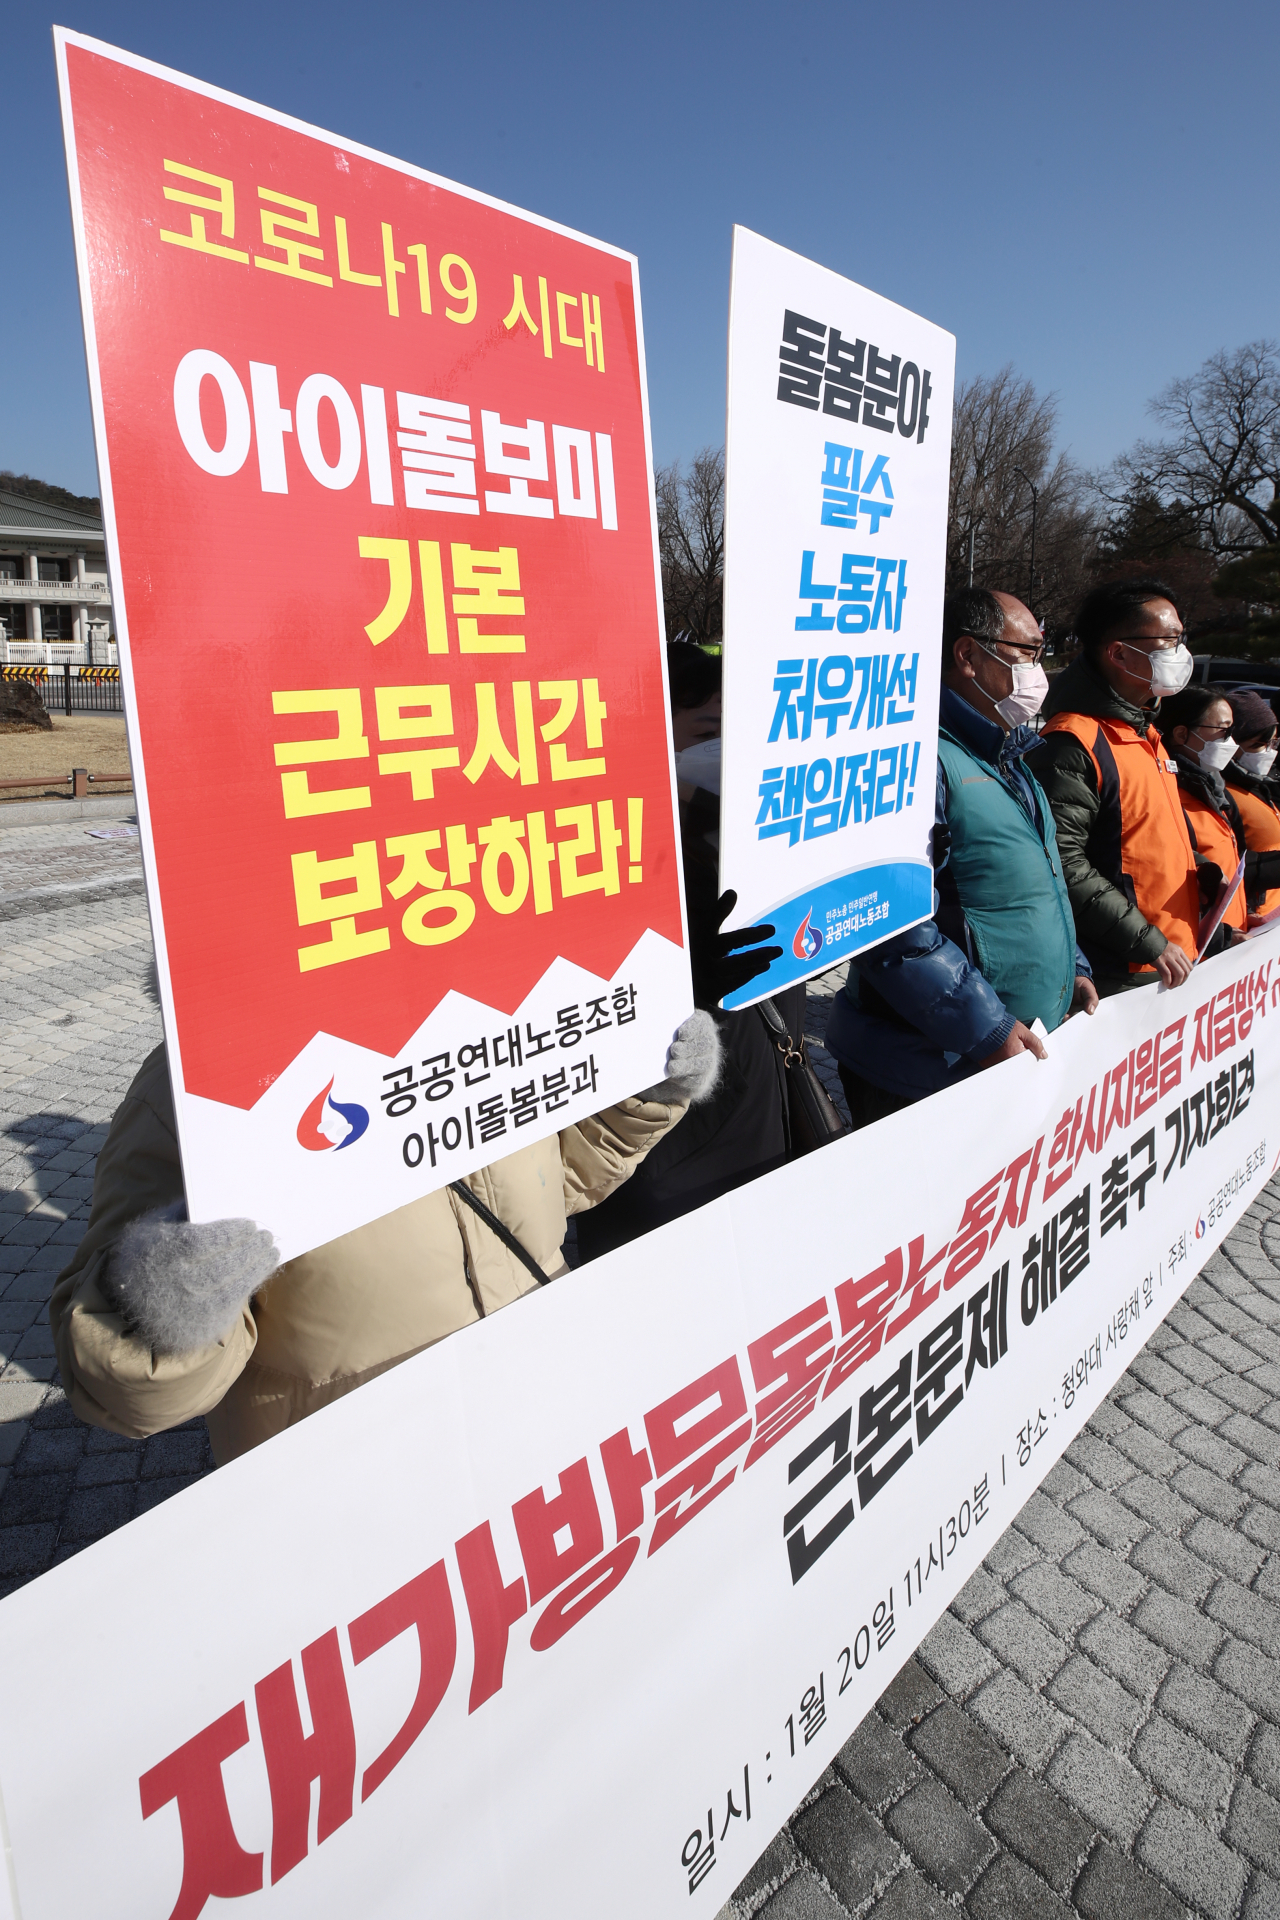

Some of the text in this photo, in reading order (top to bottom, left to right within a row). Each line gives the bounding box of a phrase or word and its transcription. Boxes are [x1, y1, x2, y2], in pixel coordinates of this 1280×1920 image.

[159, 158, 606, 373] 코로나19 시대
[173, 348, 618, 531] 아이돌보미
[777, 308, 932, 444] 돌봄분야
[821, 441, 894, 535] 필수
[358, 535, 526, 654] 기본
[794, 550, 907, 634] 노동자
[271, 678, 607, 820] 근무시간
[767, 652, 920, 743] 처우개선
[755, 741, 921, 848] 책임져라!
[291, 797, 644, 973] 보장하라!
[825, 900, 890, 945] 공공연대노동조합
[826, 904, 848, 923] 민주노총
[380, 983, 638, 1118] 공공연대노동조합
[402, 1055, 599, 1168] 아이돌봄분과
[783, 1048, 1255, 1586] 근본문제 해결 촉구 기자회견
[138, 958, 1274, 1920] 재가방문돌봄노동자 한시지원금 지급방식
[680, 1763, 752, 1896] 일시
[784, 1672, 828, 1759] 1월
[836, 1587, 897, 1697] 20일
[903, 1472, 991, 1608] 11시30분
[1016, 1407, 1049, 1467] 장소
[1062, 1333, 1102, 1410] 청와대
[1105, 1286, 1141, 1352] 사랑채
[1142, 1271, 1153, 1310] 앞
[1168, 1230, 1187, 1276] 주최
[1207, 1138, 1267, 1228] 공공연대노동조합
